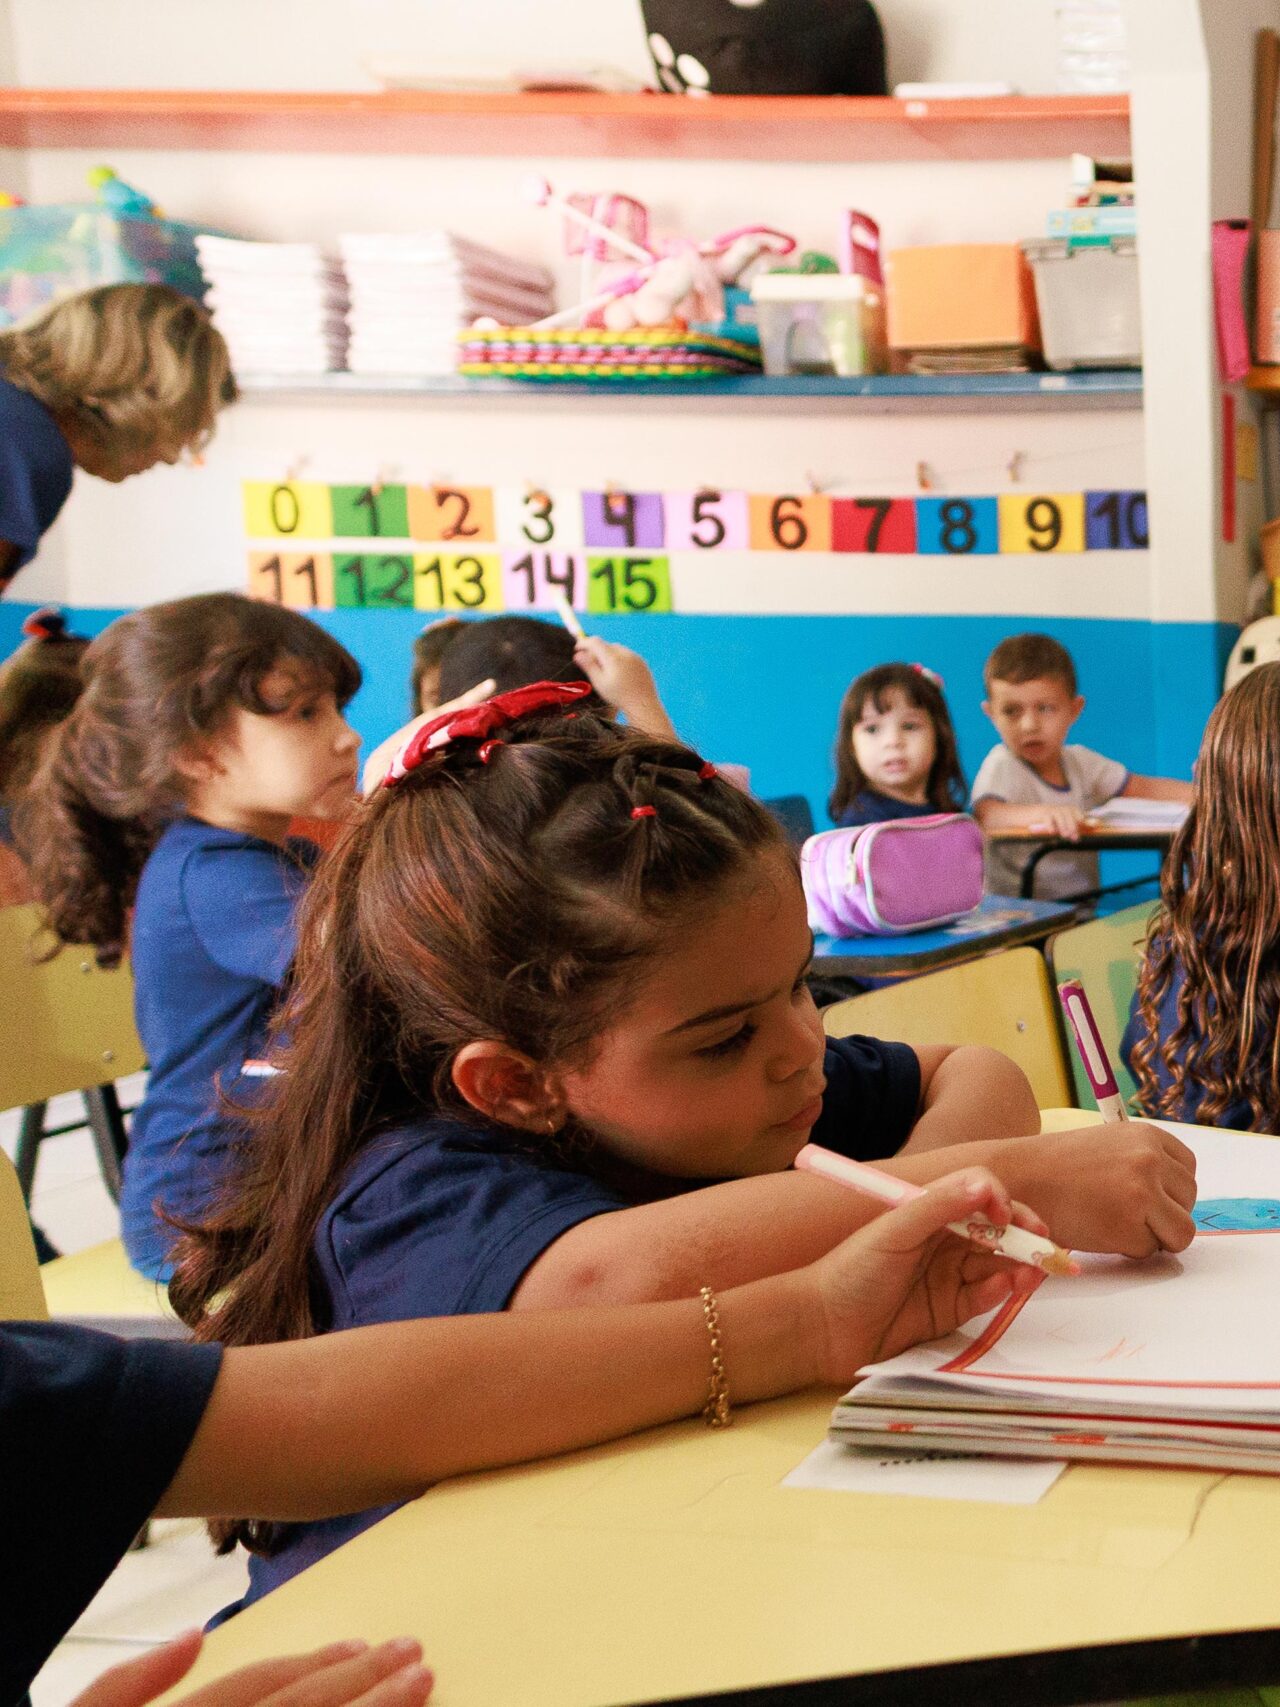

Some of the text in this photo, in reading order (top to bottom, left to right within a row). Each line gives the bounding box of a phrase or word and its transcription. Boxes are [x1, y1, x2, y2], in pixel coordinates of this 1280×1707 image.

[271, 485, 299, 534] 0
[353, 485, 381, 536] 1
[434, 489, 480, 540] 2
[521, 490, 555, 544] 3
[603, 490, 636, 548] 4
[691, 487, 725, 548] 5
[770, 495, 807, 550] 6
[853, 496, 892, 554] 7
[938, 498, 977, 554] 8
[1025, 497, 1061, 553] 9
[258, 553, 657, 610] 11 12 13 14 15
